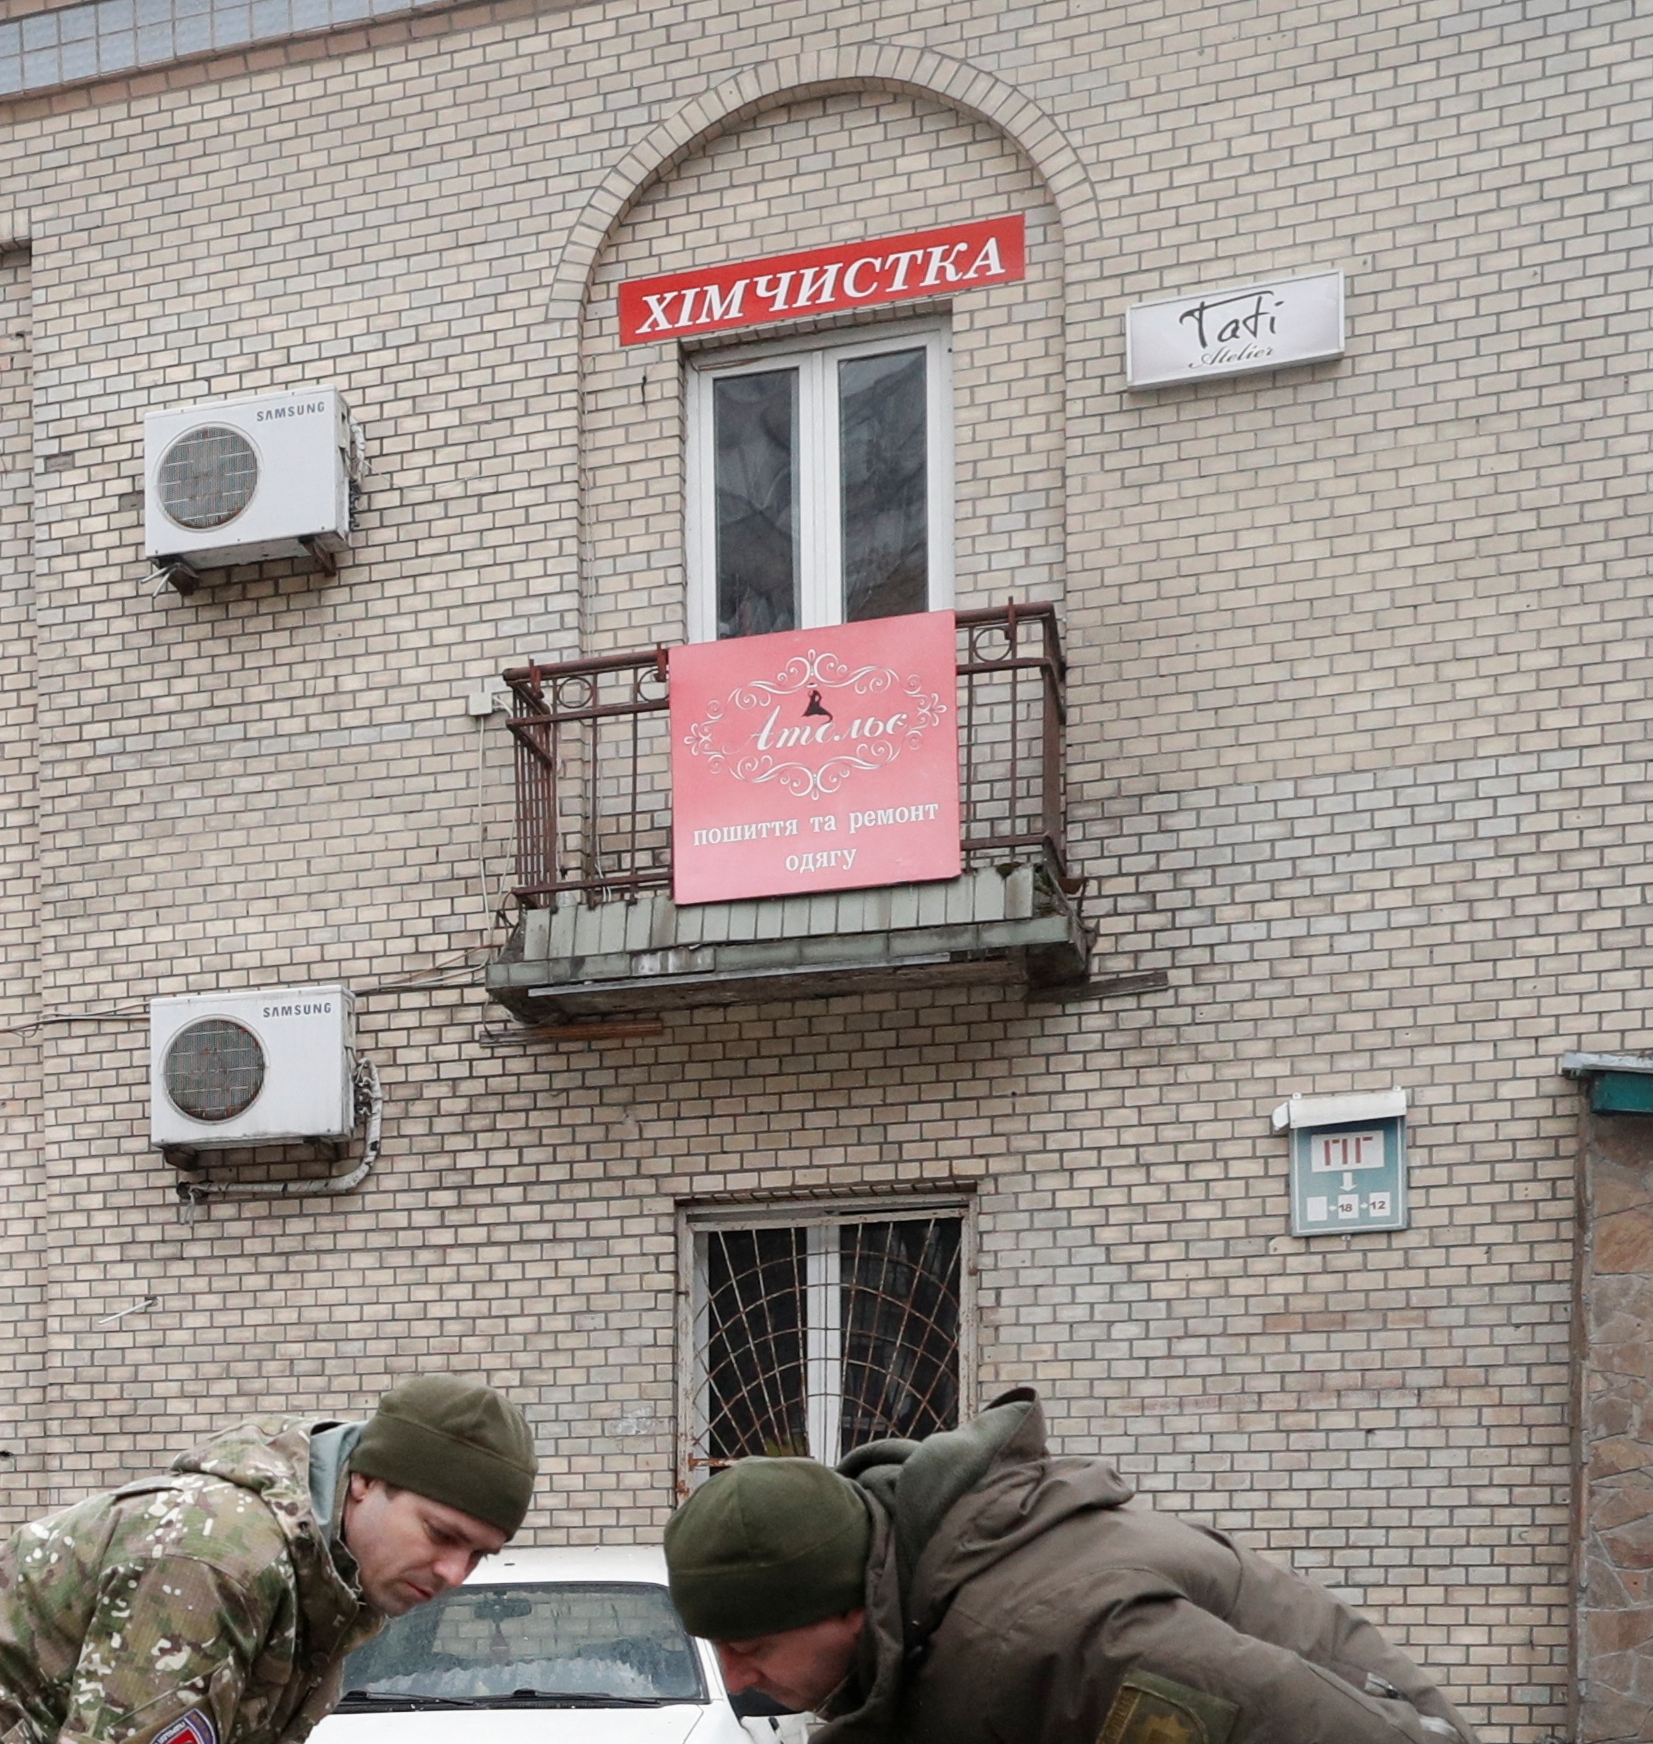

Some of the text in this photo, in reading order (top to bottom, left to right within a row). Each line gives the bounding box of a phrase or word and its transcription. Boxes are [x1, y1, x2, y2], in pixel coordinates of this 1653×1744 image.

[635, 236, 1006, 334] ХІМЧИСТКА
[1188, 343, 1274, 369] Atelier
[256, 402, 325, 422] SAMSUNG
[693, 803, 939, 846] пошиття та ремонт
[785, 848, 857, 873] одягу
[263, 1002, 332, 1018] SAMSUNG
[1323, 1135, 1374, 1167] ПГ
[1370, 1201, 1386, 1210] 12
